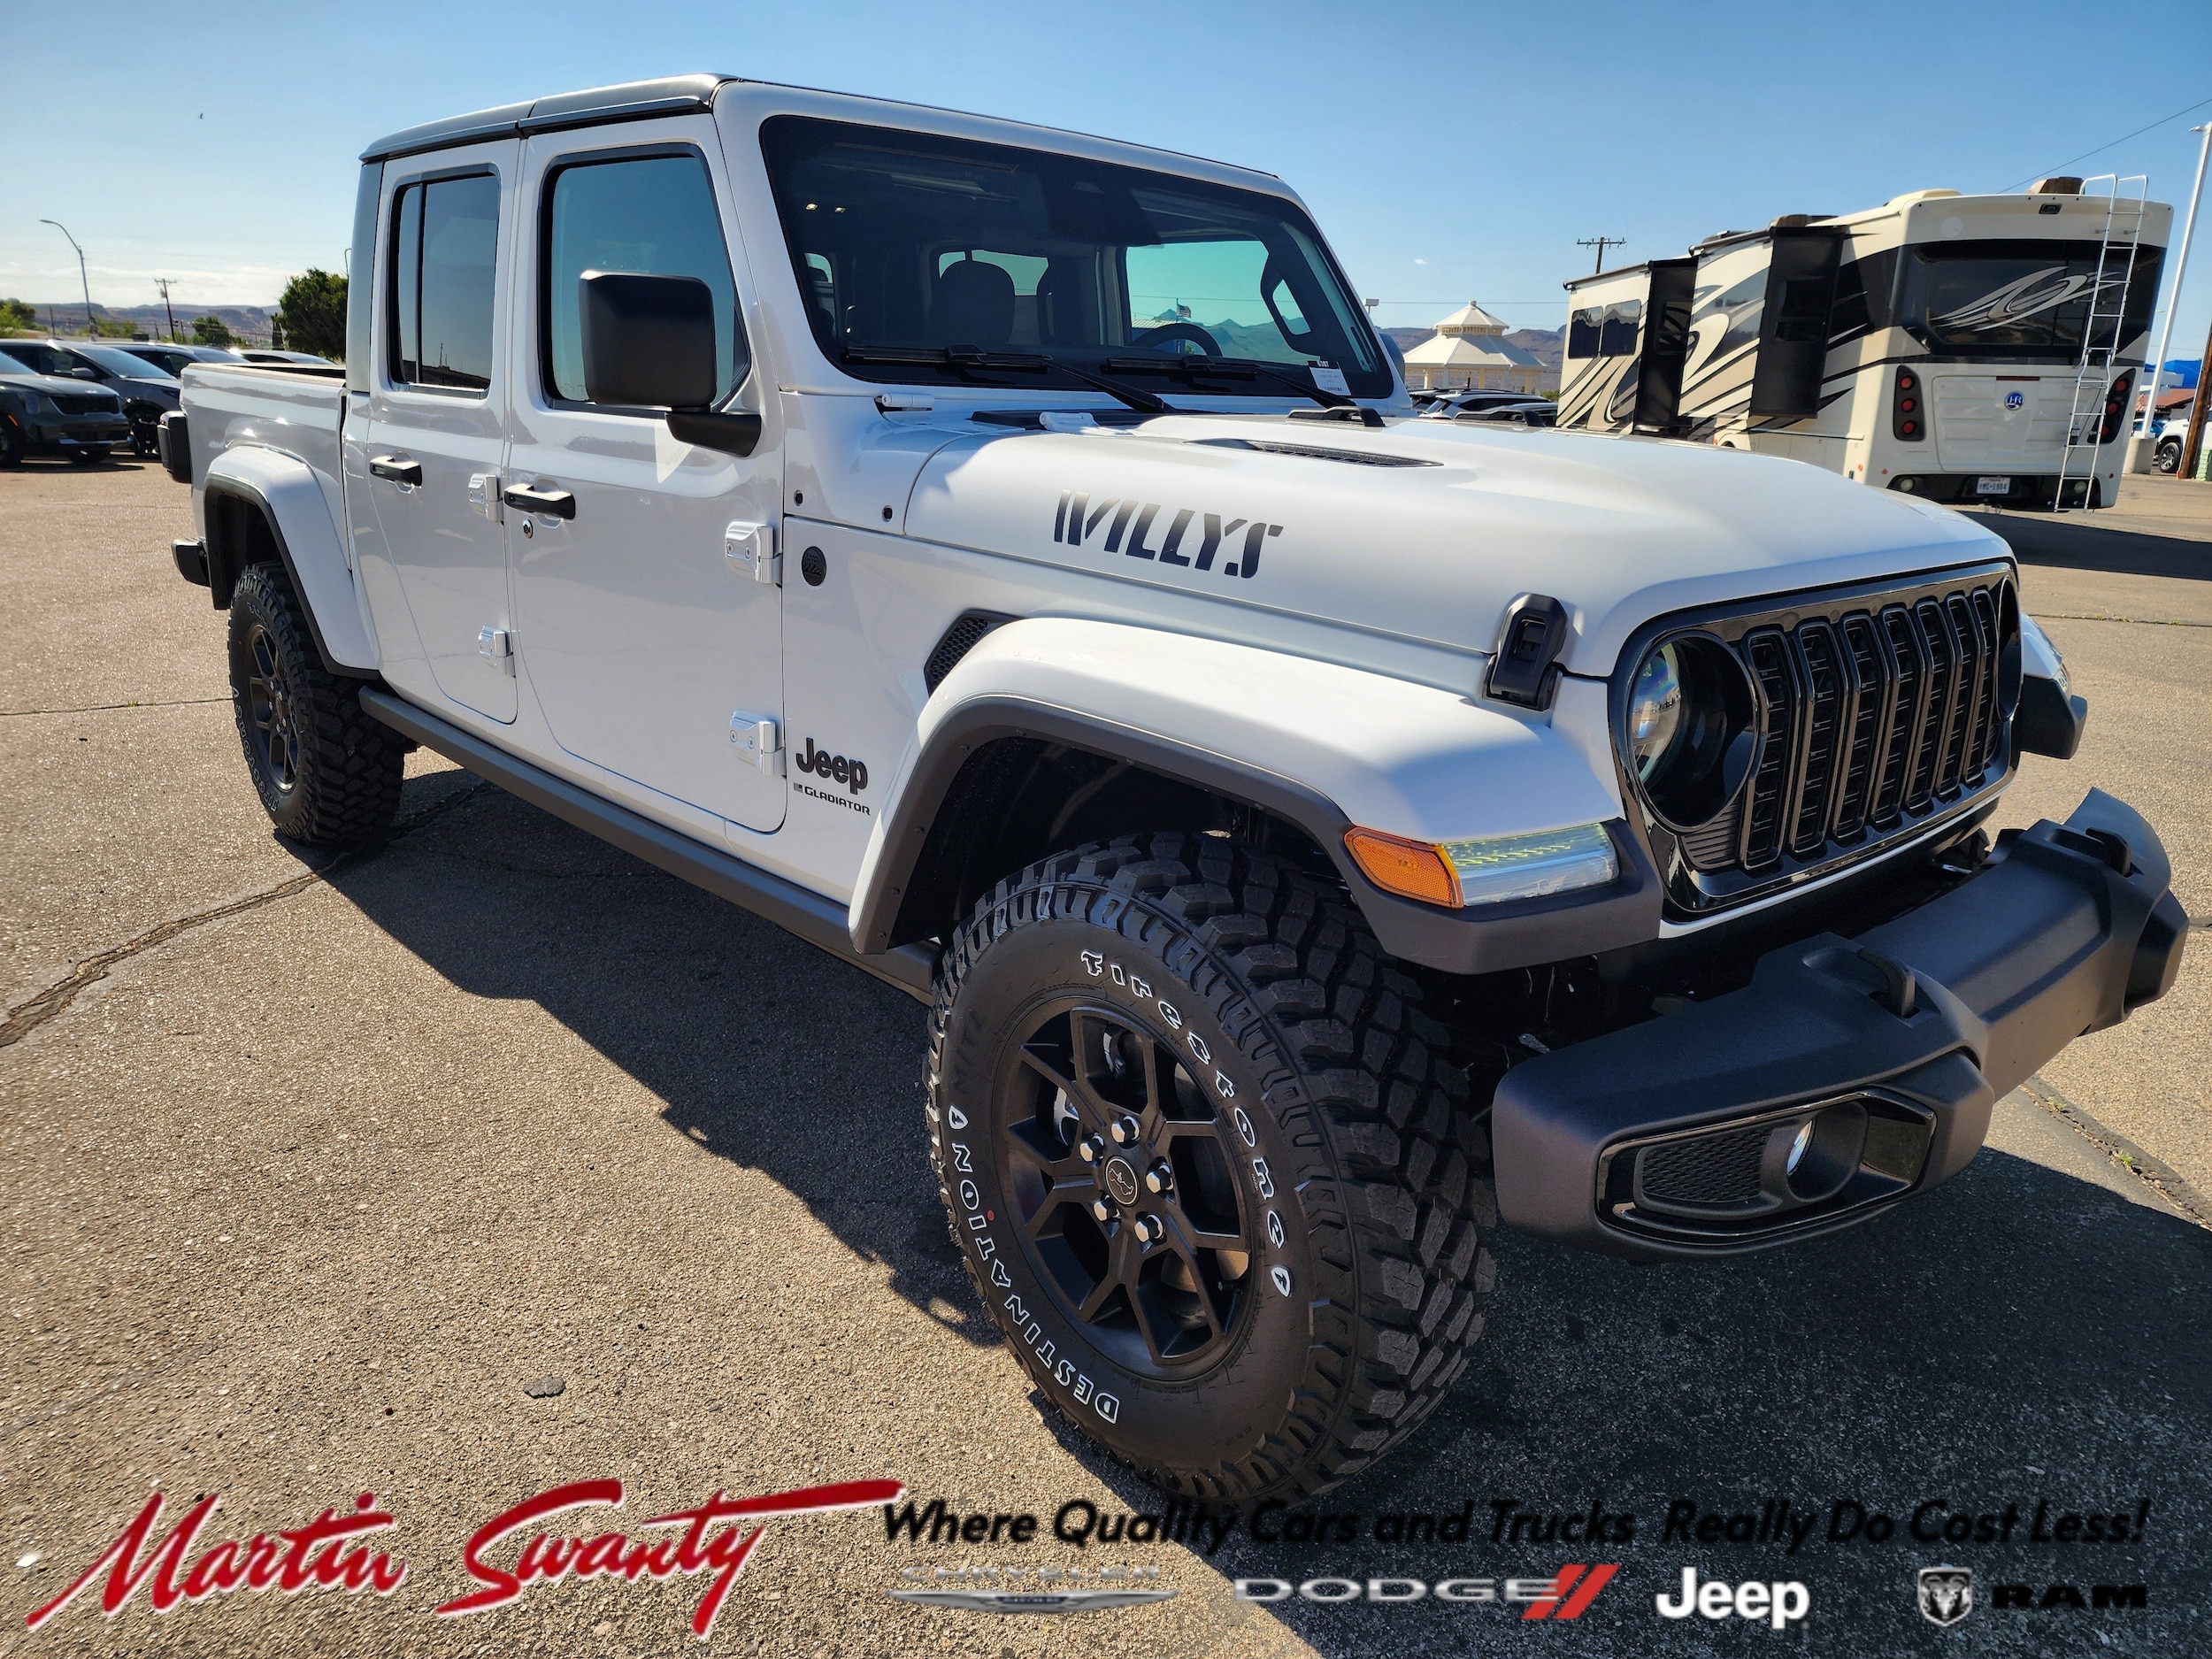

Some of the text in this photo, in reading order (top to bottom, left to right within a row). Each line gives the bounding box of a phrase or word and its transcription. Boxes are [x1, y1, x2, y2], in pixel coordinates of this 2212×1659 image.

[1054, 488, 1284, 579] WILLYS
[795, 737, 868, 795] Jeep
[804, 787, 871, 816] GLADIATOR
[951, 1143, 1121, 1425] DESTINATION
